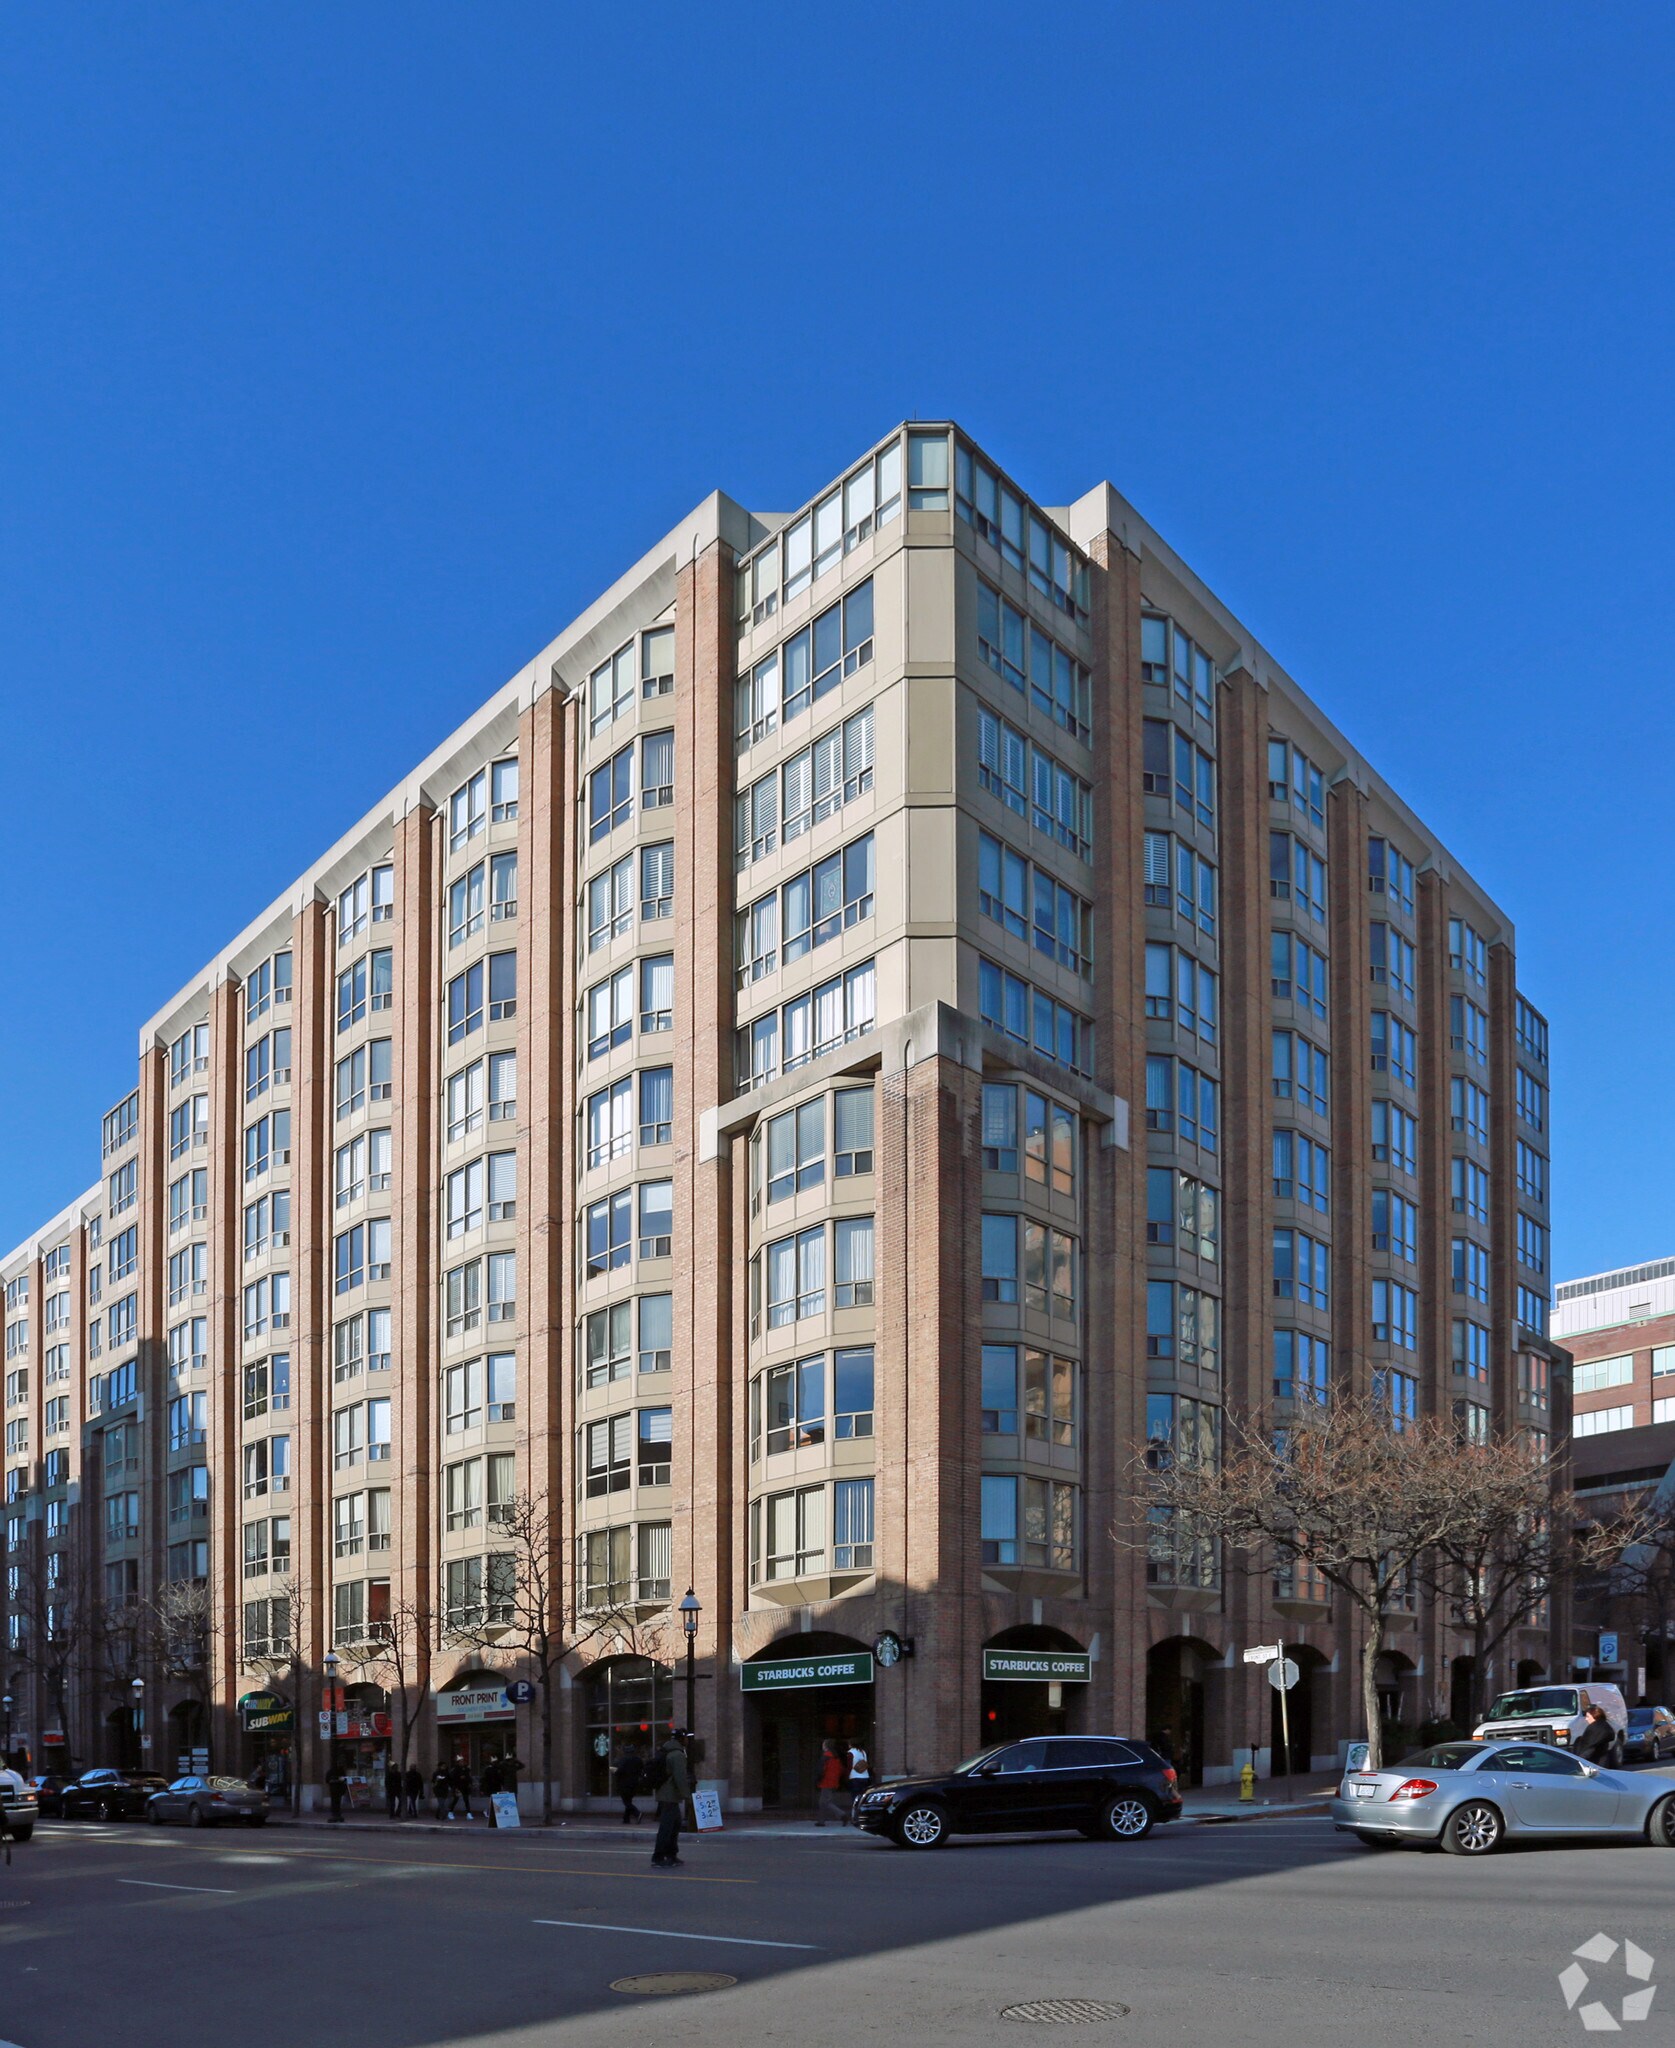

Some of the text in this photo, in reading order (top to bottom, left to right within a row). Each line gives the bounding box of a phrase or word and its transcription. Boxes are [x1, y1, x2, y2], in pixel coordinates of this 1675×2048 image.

[757, 1664, 855, 1681] STARBUCKS COFFEE
[989, 1659, 1085, 1673] STARBUCKS COFFEE
[518, 1682, 528, 1696] P
[452, 1692, 499, 1706] FRONT PRINT
[248, 1711, 291, 1729] SUBWAY
